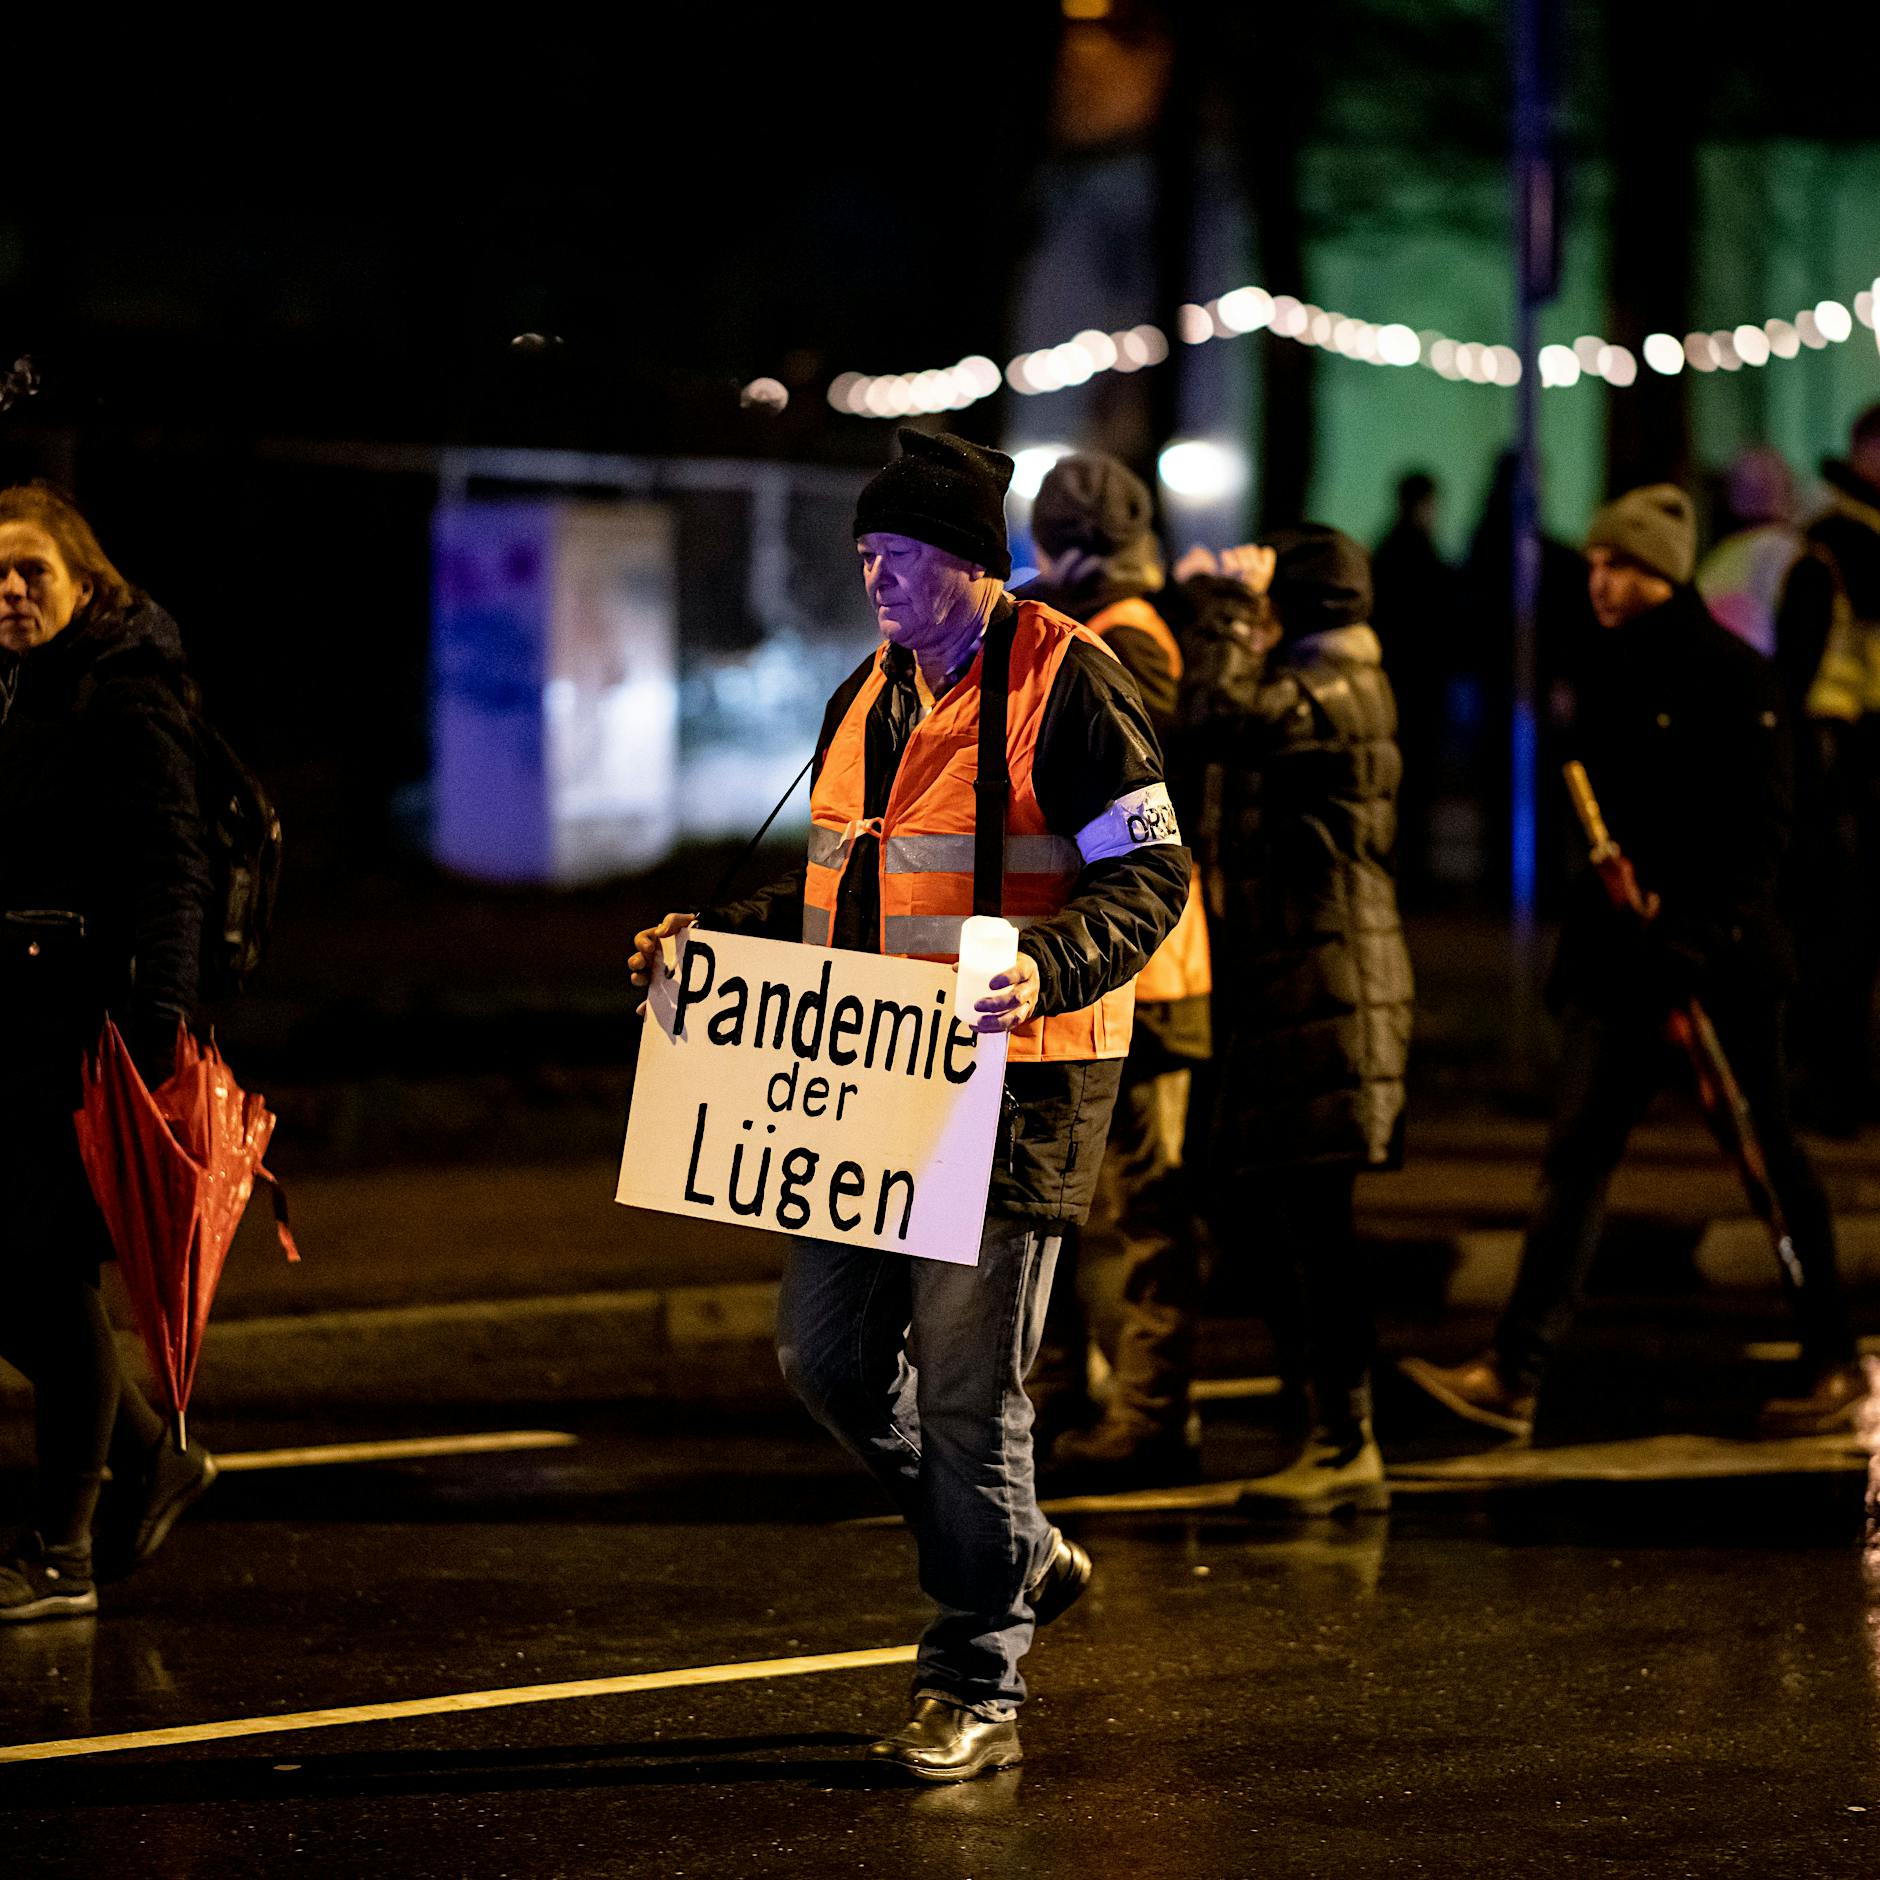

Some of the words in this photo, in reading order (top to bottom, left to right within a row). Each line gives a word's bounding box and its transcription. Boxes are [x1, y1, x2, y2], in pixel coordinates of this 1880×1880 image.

[673, 939, 977, 1084] Pandemie
[767, 1062, 858, 1121] der
[684, 1103, 915, 1240] Lügen
